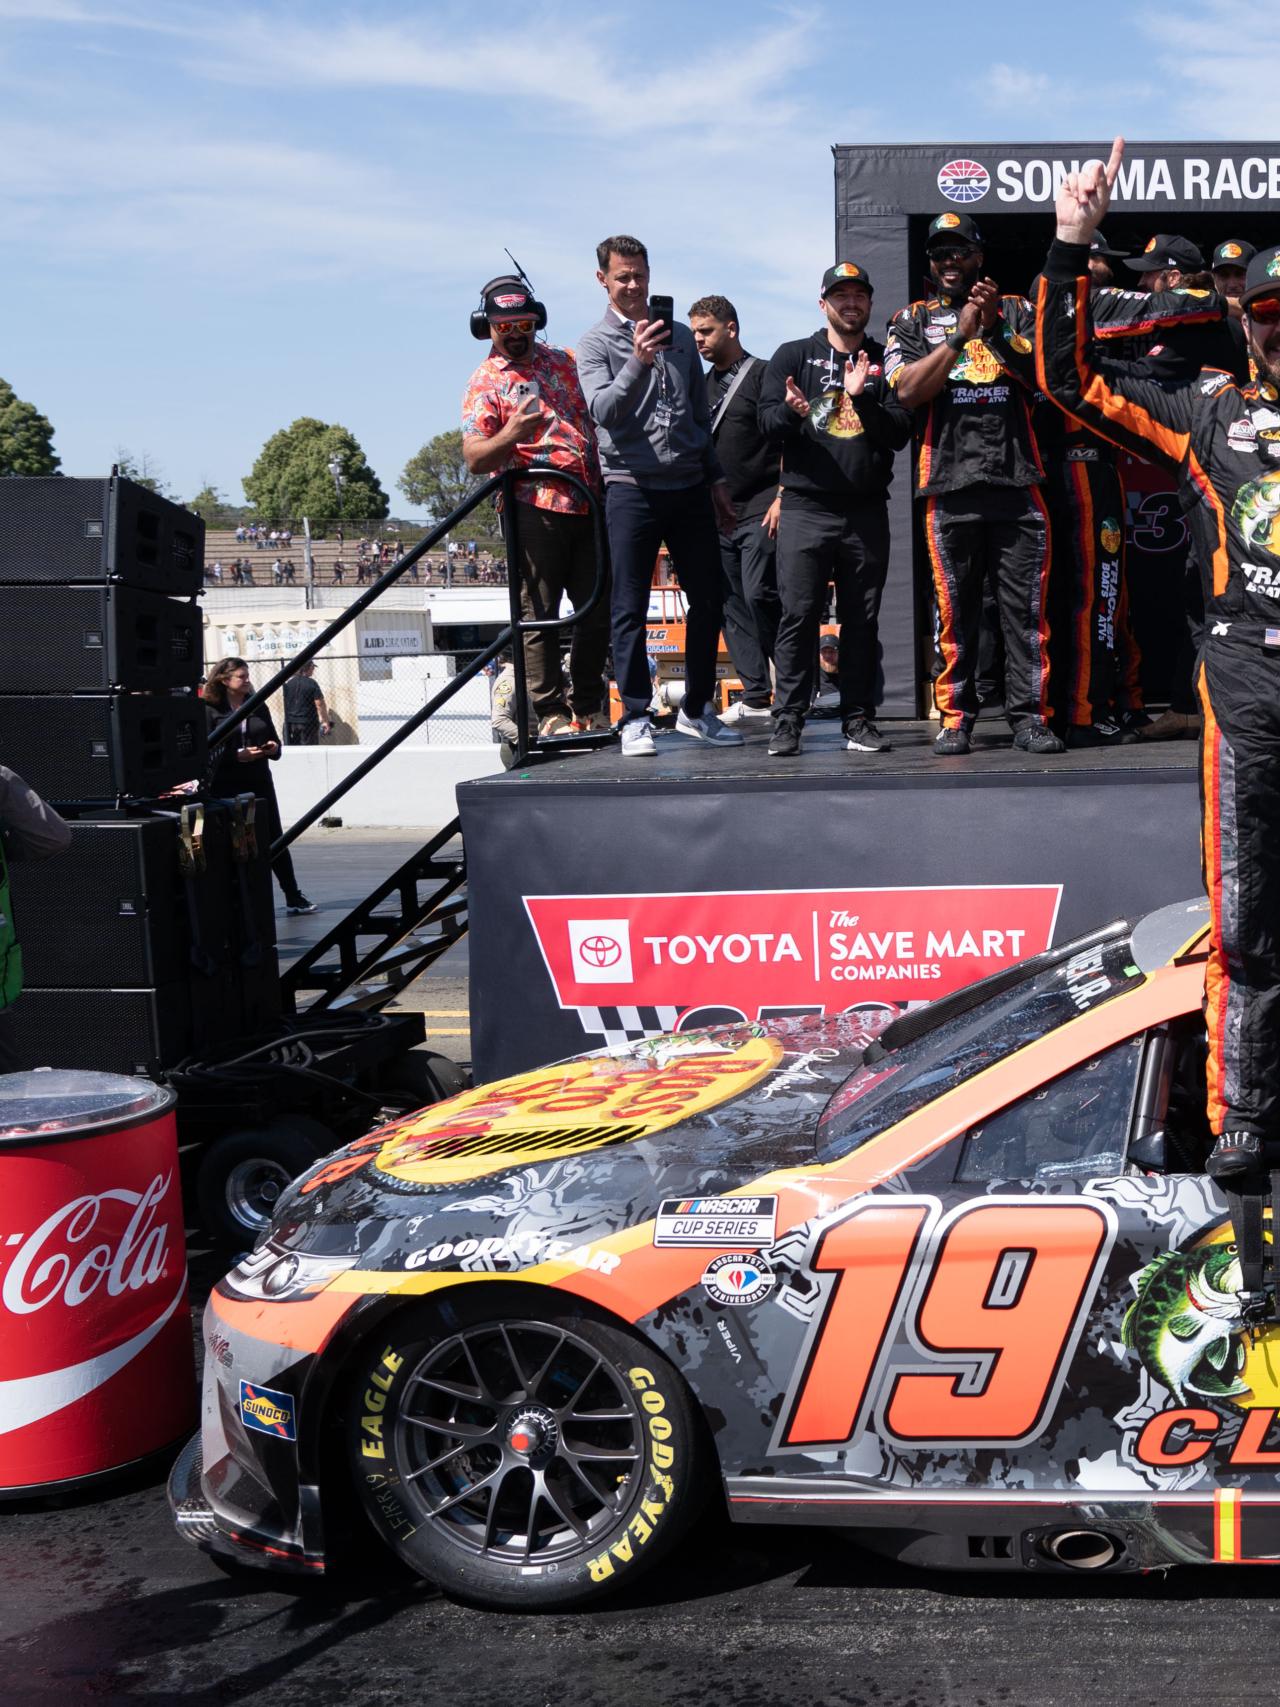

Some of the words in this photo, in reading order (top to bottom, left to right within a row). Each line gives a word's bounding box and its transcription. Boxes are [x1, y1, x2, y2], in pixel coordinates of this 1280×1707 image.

[969, 341, 985, 353] Ba
[975, 363, 1003, 375] Shop
[951, 386, 1011, 398] TRACKER
[836, 418, 864, 433] Shop
[1101, 561, 1111, 598] BOATS
[1105, 559, 1119, 650] TRACKER
[829, 910, 859, 929] The
[643, 933, 802, 965] TOYOTA
[830, 932, 925, 961] SAVE
[929, 929, 1026, 958] MART
[830, 964, 941, 981] COMPANIES
[697, 1198, 761, 1214] NASCAR
[672, 1221, 699, 1236] CUP
[703, 1219, 758, 1236] SERIES
[0, 1167, 173, 1315] -Cola
[405, 1231, 621, 1276] GOODYEAR
[710, 1254, 744, 1271] NASCAR
[746, 1255, 766, 1271] 75TH
[709, 1285, 767, 1304] ANNIVERSARY
[766, 1195, 1119, 1456] 19
[716, 1319, 742, 1364] VIPER
[245, 1401, 289, 1421] SUNOCO
[361, 1345, 405, 1459] EAGLE
[586, 1367, 674, 1582] GOODYEAR
